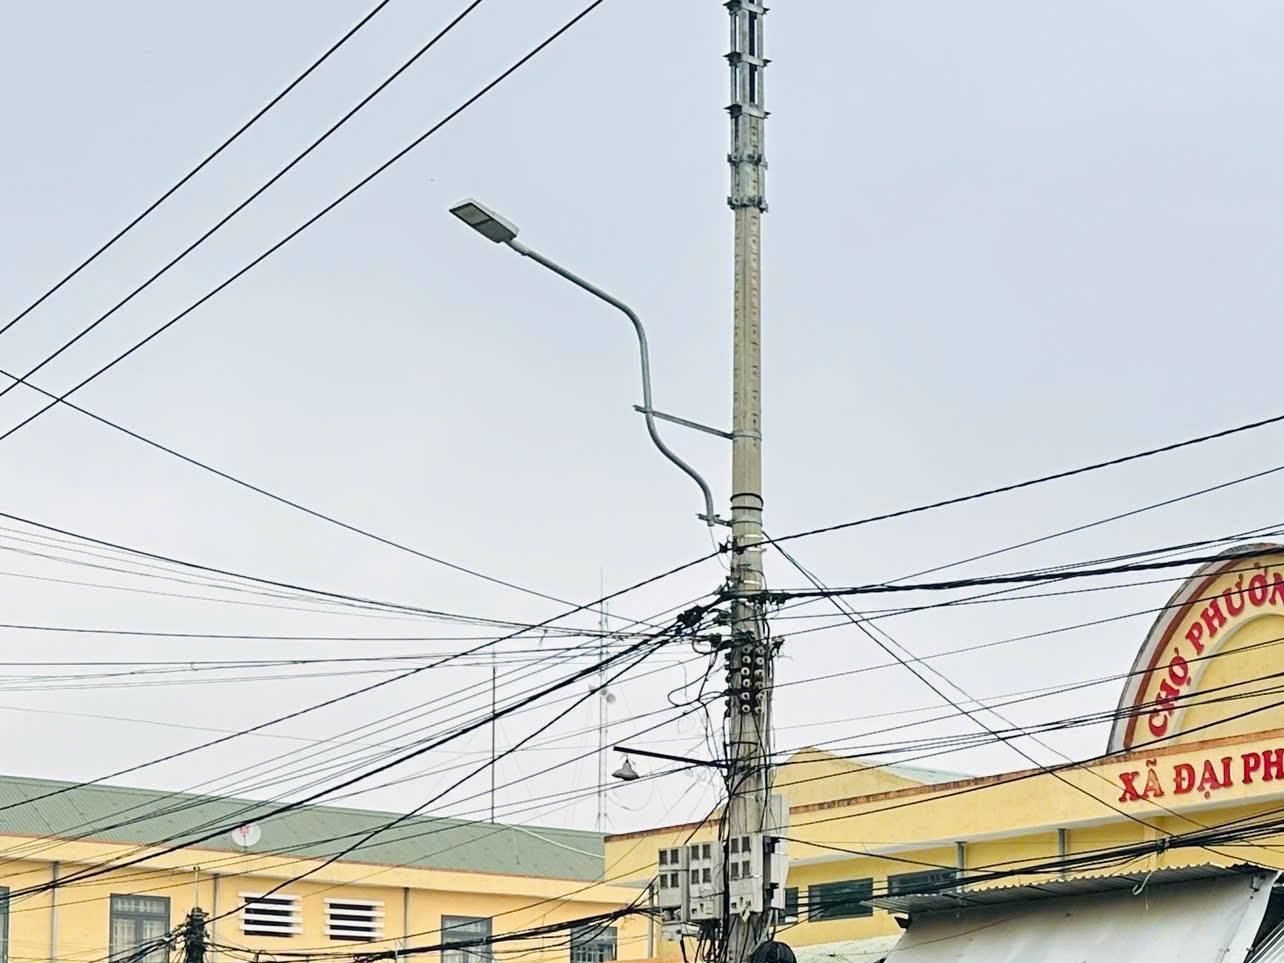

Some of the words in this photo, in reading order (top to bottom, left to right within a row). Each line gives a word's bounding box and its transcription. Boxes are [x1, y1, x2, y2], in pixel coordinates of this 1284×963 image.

[1148, 646, 1192, 738] CHỢ
[1118, 758, 1165, 802] XÃ
[1172, 755, 1234, 800] ĐẠI
